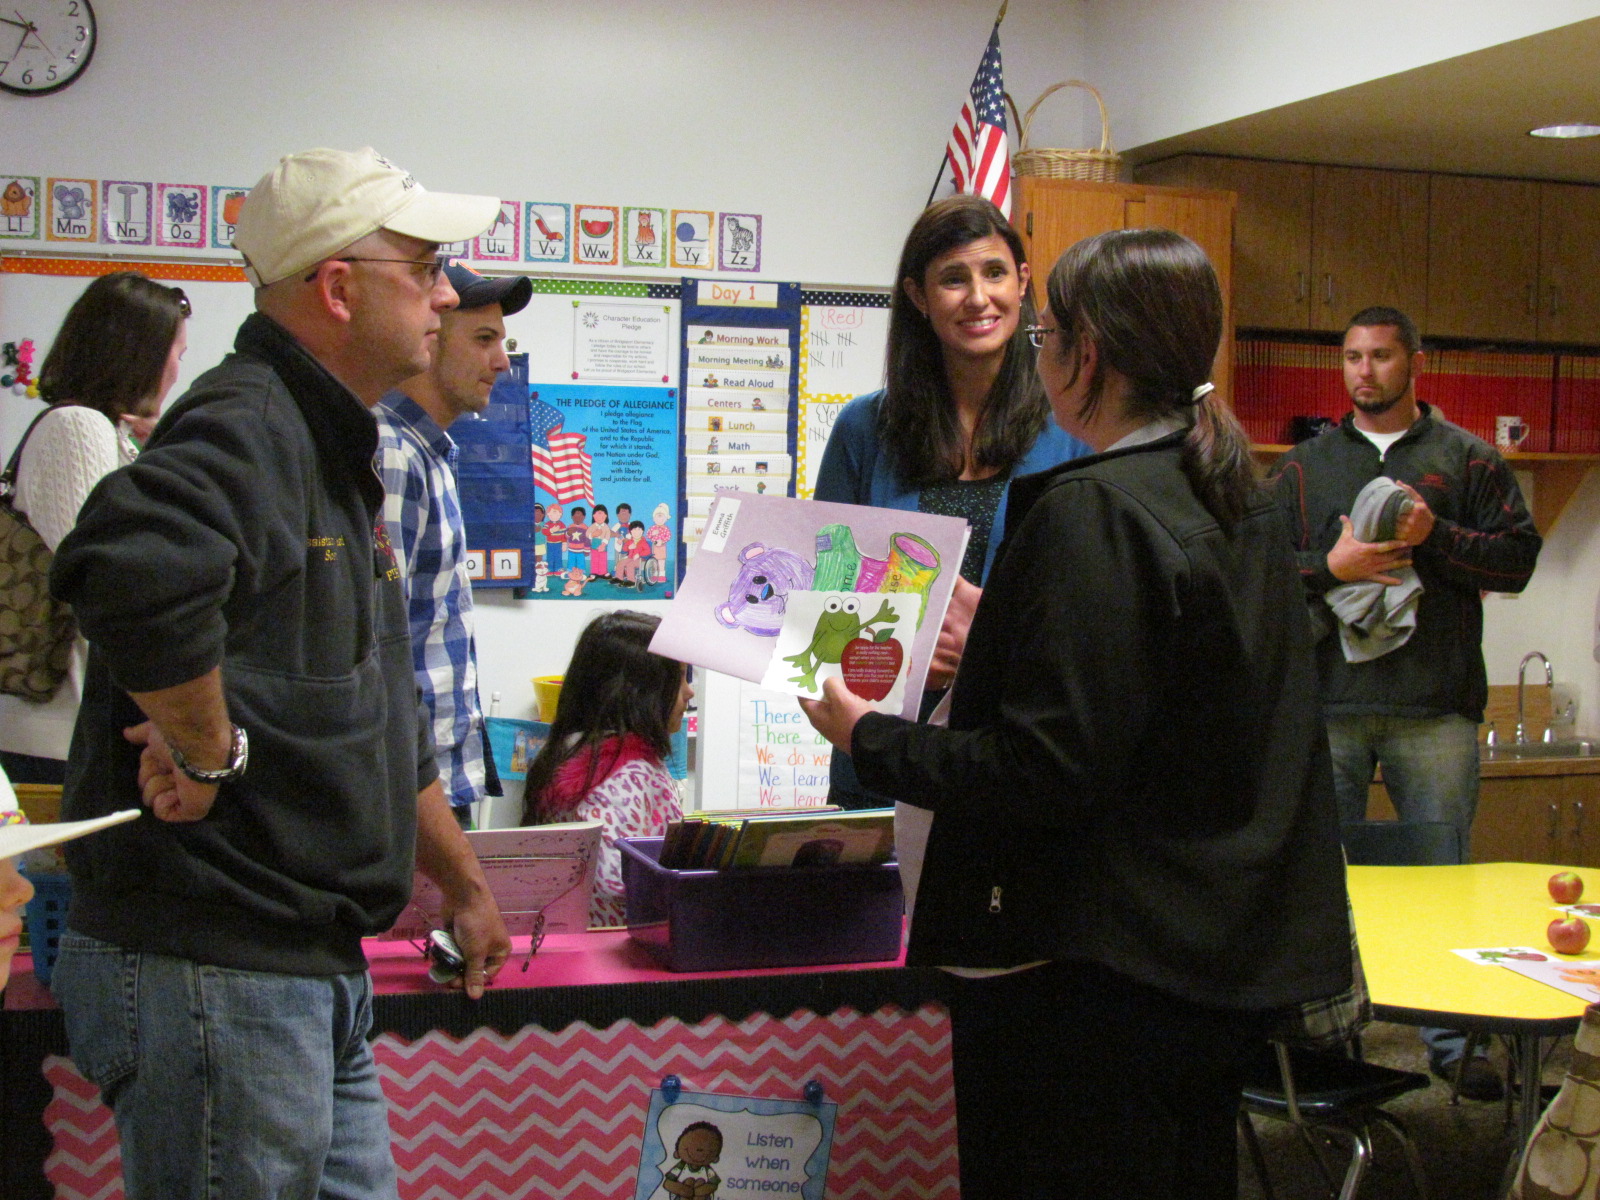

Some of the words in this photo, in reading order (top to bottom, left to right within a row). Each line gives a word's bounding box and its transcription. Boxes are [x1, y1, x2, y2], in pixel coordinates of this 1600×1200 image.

[68, 1, 79, 17] 2
[75, 26, 86, 42] 3
[66, 49, 77, 64] 4
[22, 69, 33, 85] 6
[46, 65, 57, 81] 5
[57, 218, 87, 234] Mm
[117, 222, 137, 238] Nn
[170, 223, 192, 240] Oo
[486, 239, 505, 253] Uu
[538, 241, 557, 255] Vv
[582, 243, 609, 259] Ww
[636, 244, 653, 260] Xx
[683, 246, 700, 263] Yy
[731, 250, 748, 265] Zz
[711, 284, 741, 304] Day
[749, 286, 756, 301] 1
[621, 323, 642, 331] Pledge
[716, 334, 754, 346] Morning
[756, 336, 779, 345] Work
[698, 356, 731, 366] Morning
[732, 357, 764, 366] Meeting
[723, 378, 746, 387] Read
[748, 379, 774, 388] Aloud
[556, 398, 572, 407] THE
[574, 399, 606, 408] PLEDGE
[608, 400, 621, 408] OF
[623, 400, 675, 410] ALLEGIANCE
[707, 399, 742, 408] Centers
[728, 421, 756, 431] Lunch
[728, 442, 751, 451] Math
[624, 468, 644, 476] liberty
[731, 465, 746, 475] Art
[612, 476, 632, 484] justice
[712, 512, 726, 537] Emma
[466, 559, 476, 570] o
[501, 558, 512, 570] n
[750, 700, 802, 724] There
[752, 724, 802, 744] There
[755, 743, 776, 766] We
[787, 747, 806, 767] do
[759, 764, 781, 787] We
[793, 767, 830, 787] learn
[760, 785, 782, 807] We
[747, 1131, 794, 1149] Listen
[745, 1155, 790, 1171] when
[727, 1176, 800, 1193] someone
